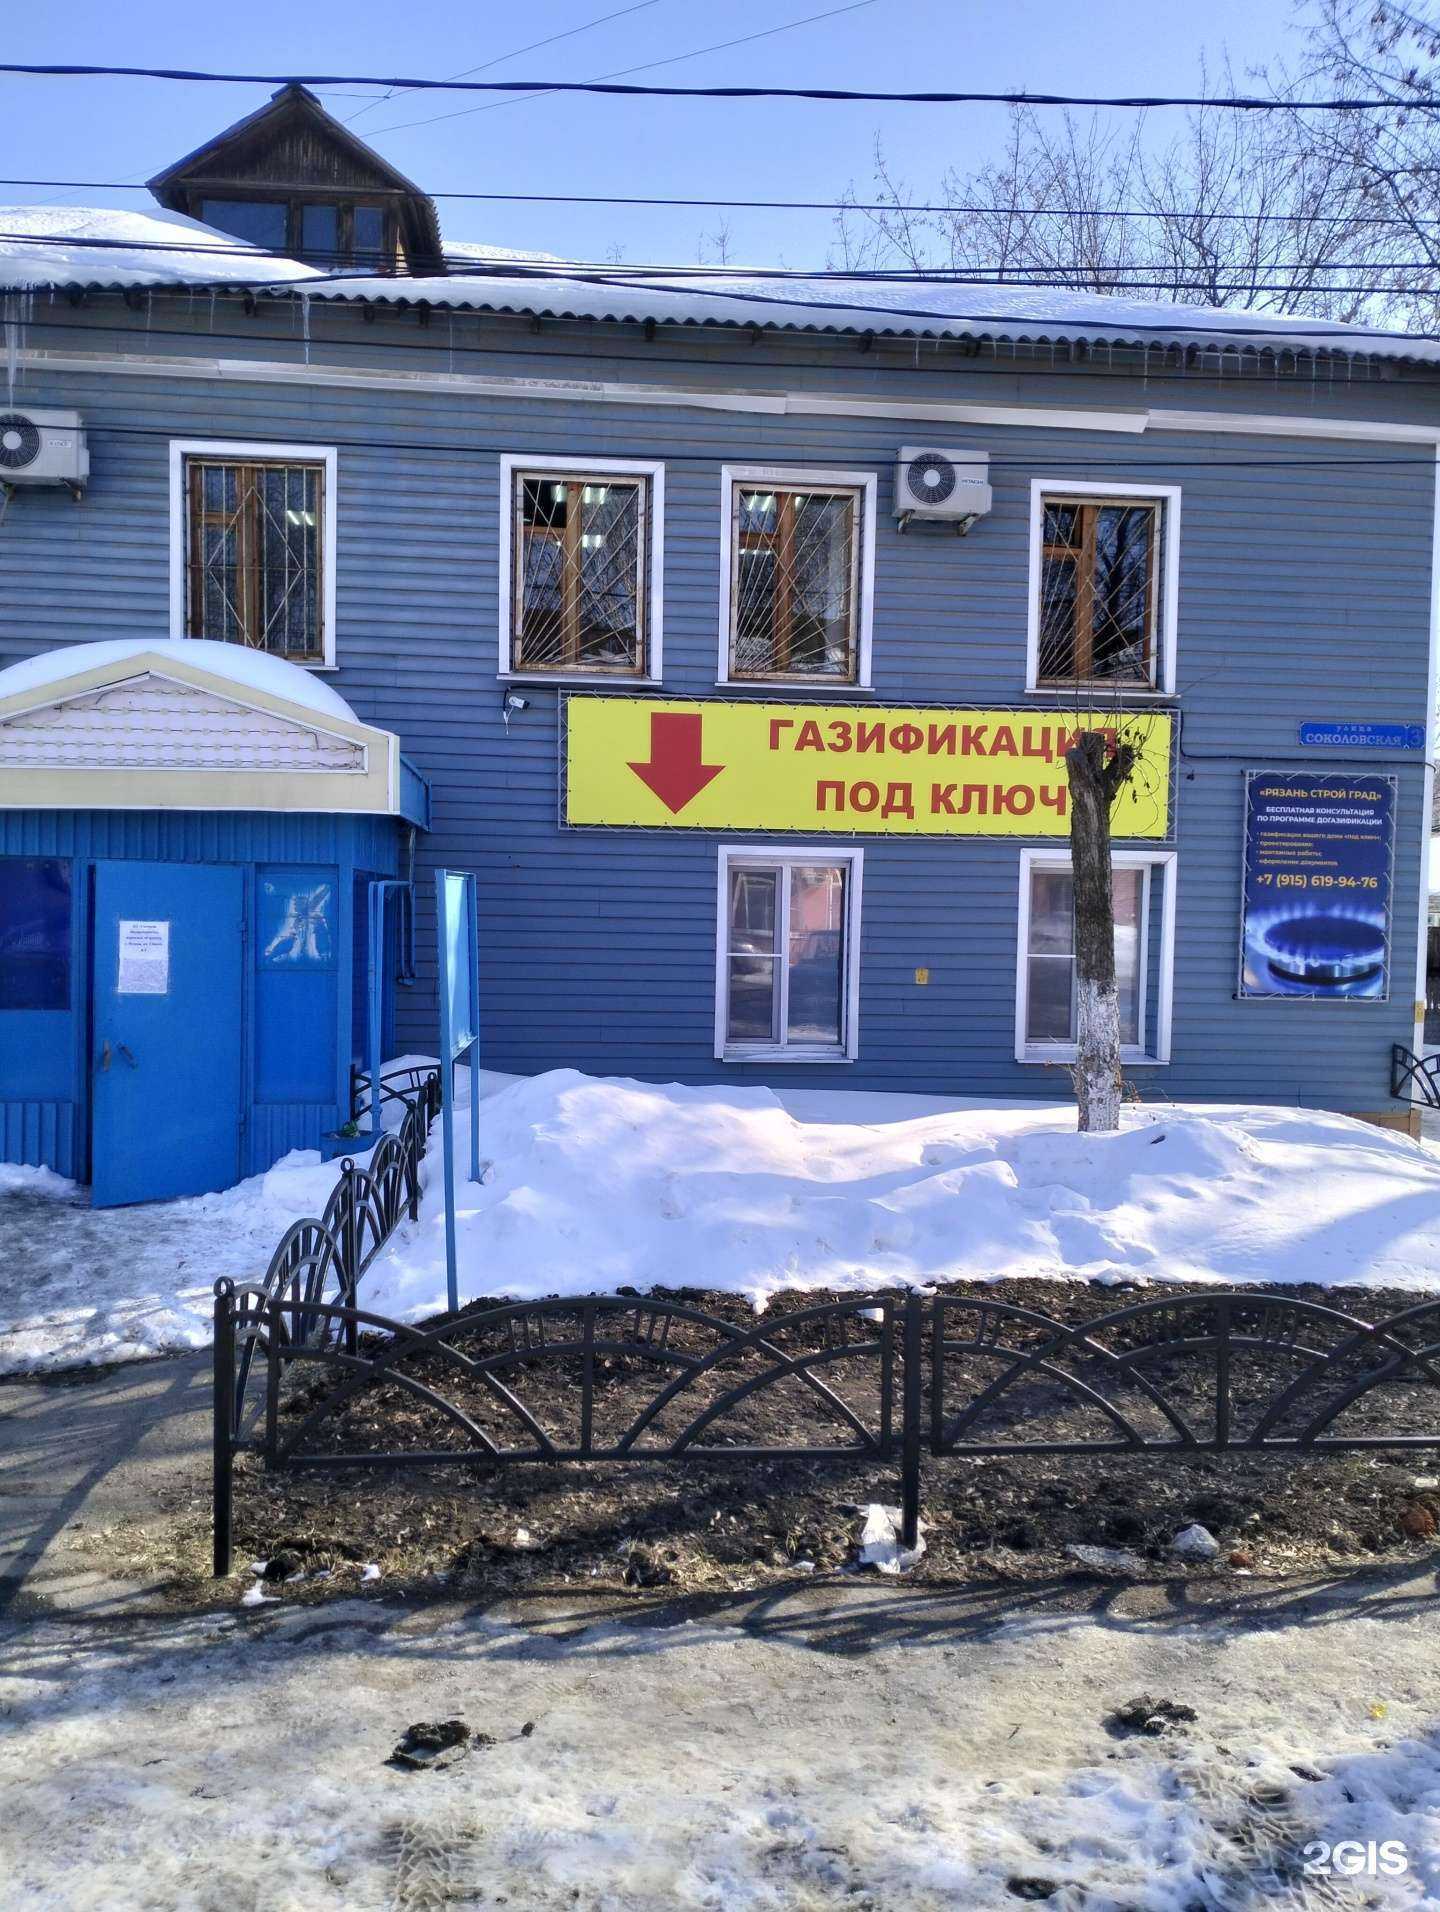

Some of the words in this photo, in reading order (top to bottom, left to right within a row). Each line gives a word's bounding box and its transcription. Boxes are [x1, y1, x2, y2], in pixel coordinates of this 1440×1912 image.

[1306, 733, 1402, 745] СОКОЛОВСКАЯ
[816, 780, 915, 820] ПОД
[930, 783, 1066, 816] КЛЮЧ
[1259, 788, 1309, 798] «РЯЗАНЬ
[1310, 788, 1347, 799] СТРОЙ
[1349, 790, 1382, 801] ГРАД»
[1265, 806, 1314, 814] БЕСПЛАТНАЯ
[1316, 807, 1375, 816] КОНСУЛЬТАЦИЯ
[1257, 815, 1269, 823] ПО
[1269, 815, 1316, 824] ПРОГРАММЕ
[1316, 817, 1383, 826] ДОГАЗИФИКАЦИИ
[1257, 873, 1273, 885] +7
[1276, 873, 1307, 889] (915)
[1311, 875, 1378, 888] 619-94-76
